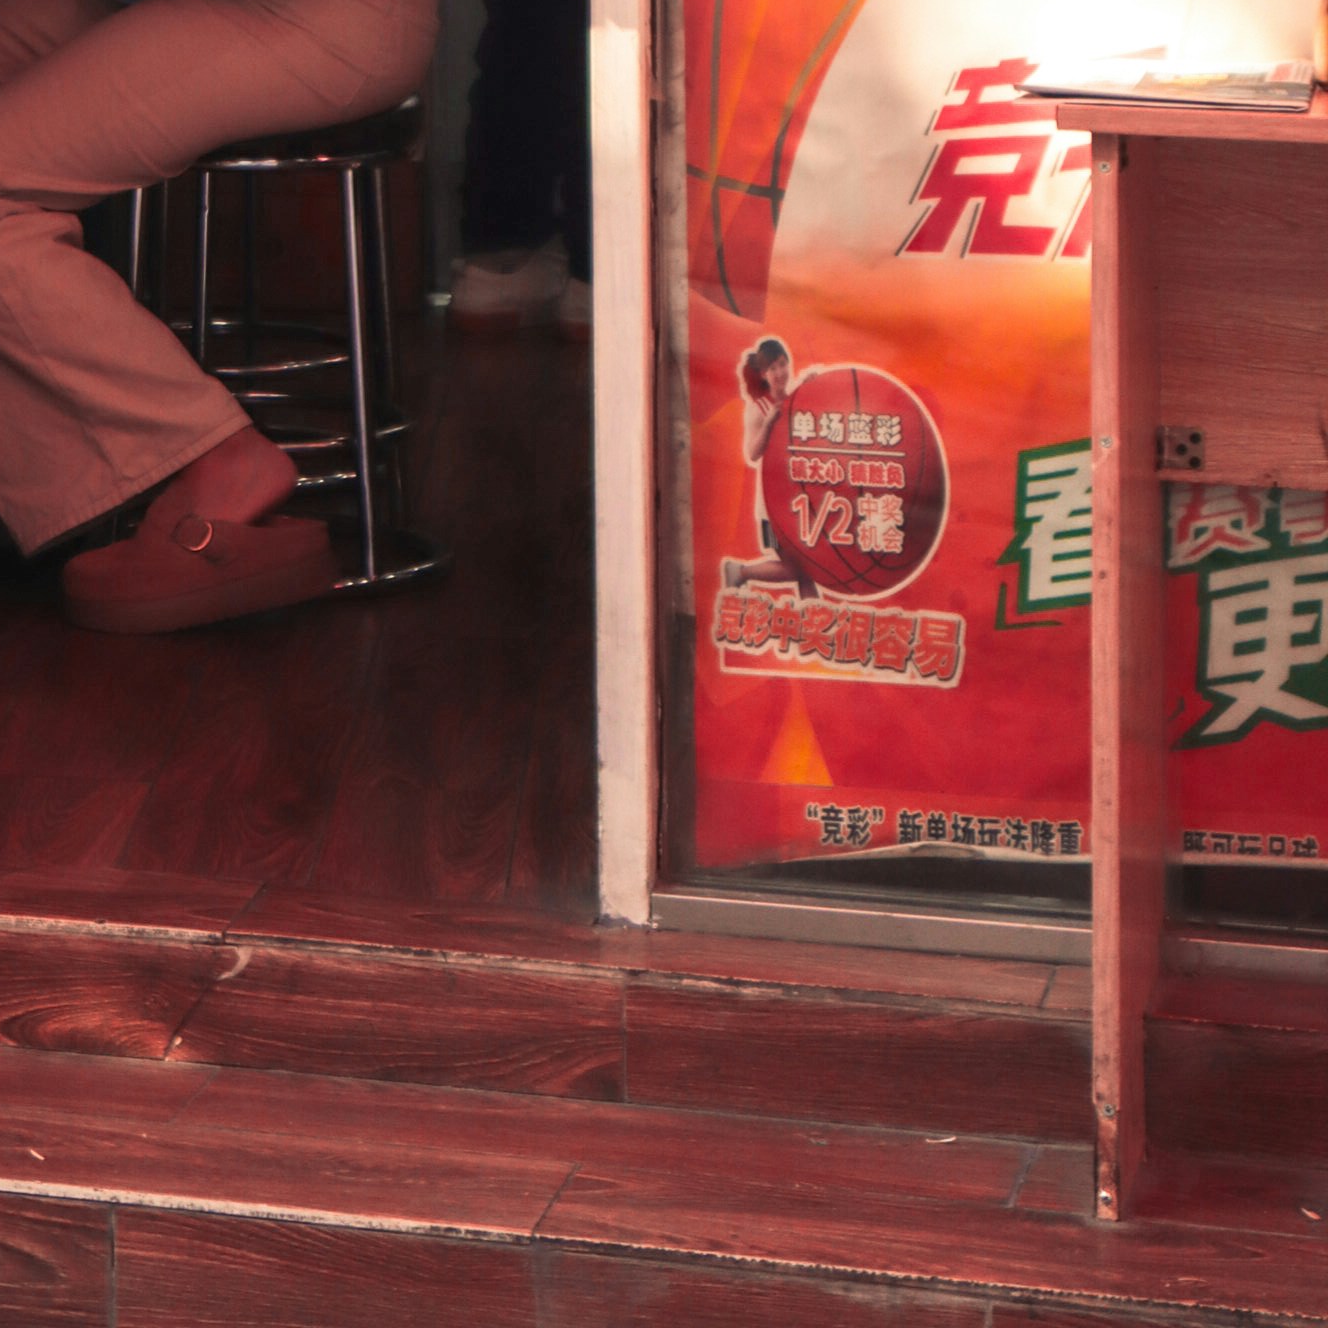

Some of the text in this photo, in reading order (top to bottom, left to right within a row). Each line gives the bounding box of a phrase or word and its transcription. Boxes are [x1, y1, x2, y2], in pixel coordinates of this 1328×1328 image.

[792, 411, 902, 445] 单场篮彩
[792, 490, 854, 547] 1/2
[857, 494, 903, 524] 中奖
[857, 525, 904, 553] 机会
[716, 593, 962, 682] 竞彩中奖很容易
